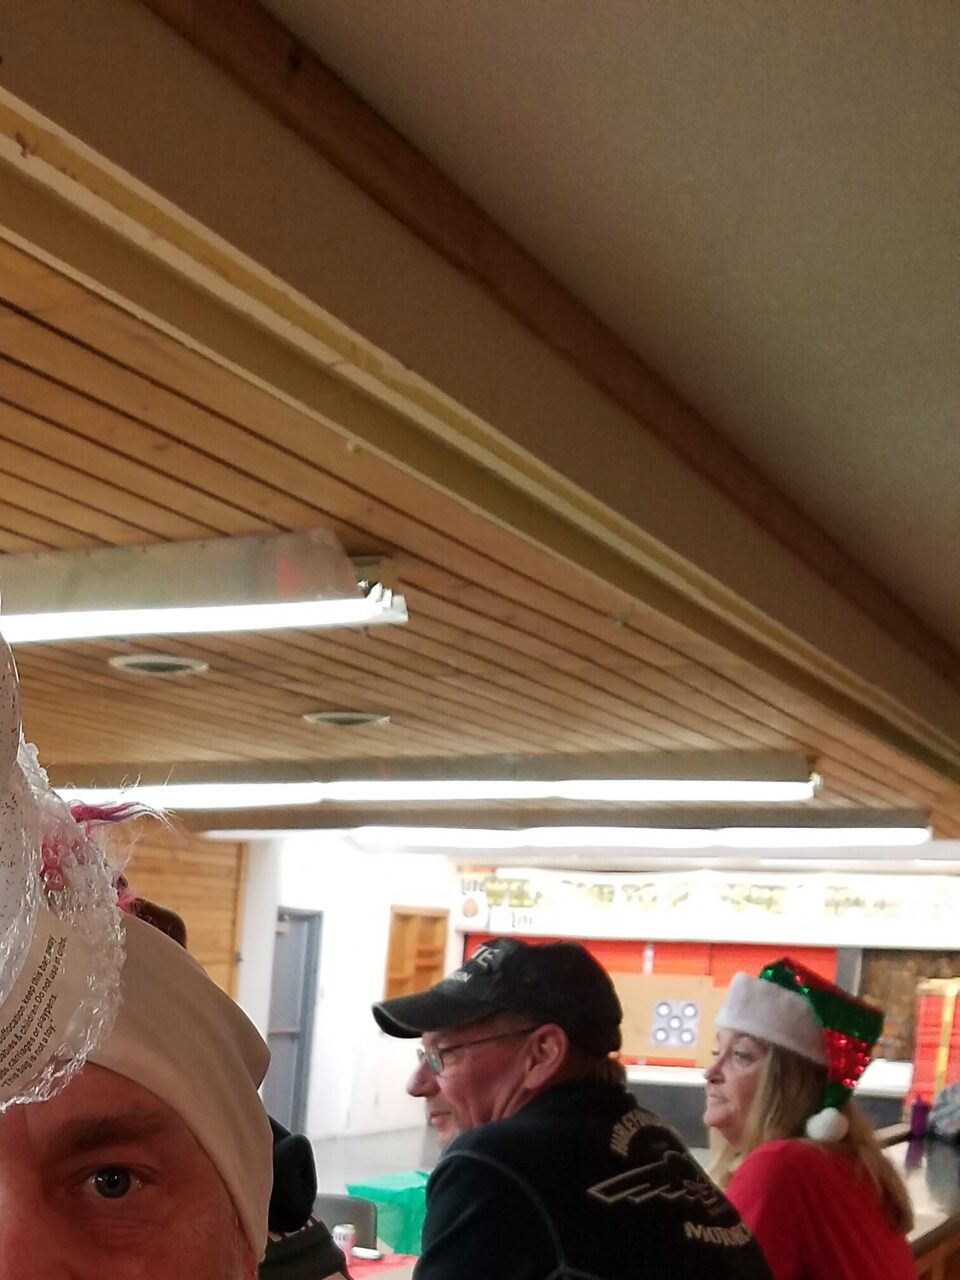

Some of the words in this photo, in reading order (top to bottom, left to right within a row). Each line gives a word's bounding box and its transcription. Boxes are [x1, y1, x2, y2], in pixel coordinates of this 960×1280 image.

[14, 1033, 23, 1041] &
[42, 977, 53, 993] not
[50, 965, 59, 979] use
[21, 985, 36, 1004] keep
[31, 971, 43, 986] this
[33, 1027, 40, 1037] or
[16, 1061, 33, 1074] bag
[35, 1041, 46, 1056] not
